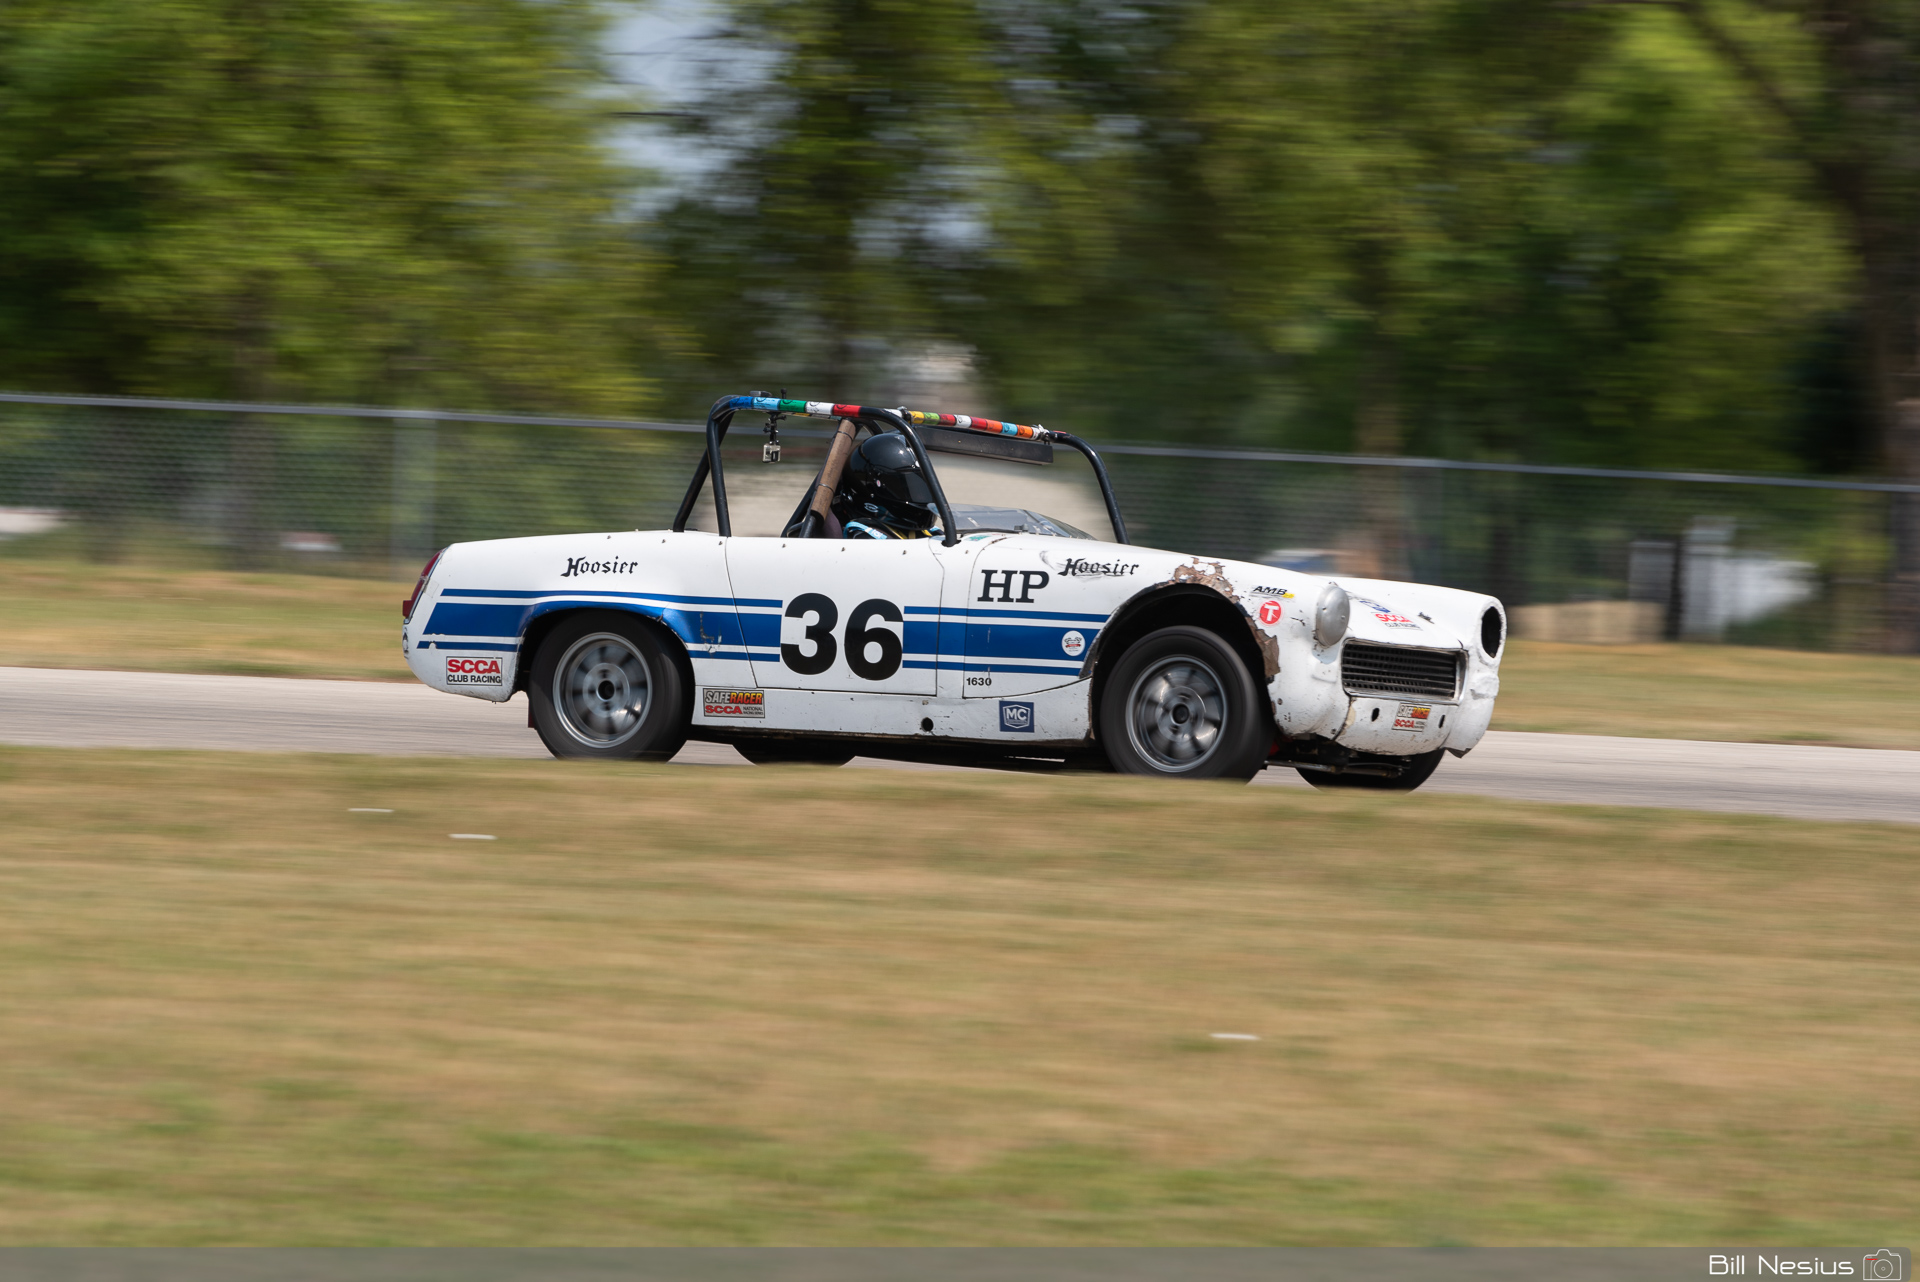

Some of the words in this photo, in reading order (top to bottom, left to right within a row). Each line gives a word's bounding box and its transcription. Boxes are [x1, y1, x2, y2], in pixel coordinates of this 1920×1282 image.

[560, 555, 639, 577] Hoosier
[1057, 557, 1140, 577] Hoosier
[977, 569, 1050, 604] HP
[1253, 585, 1288, 596] AMB
[1263, 603, 1280, 622] T
[780, 592, 904, 681] 36
[447, 659, 501, 674] SCCA
[447, 674, 469, 683] CLUB
[470, 675, 502, 684] RACING
[966, 677, 992, 687] 1630
[705, 690, 763, 705] SAFERACER
[705, 705, 743, 714] SCCA
[1006, 708, 1027, 721] MC
